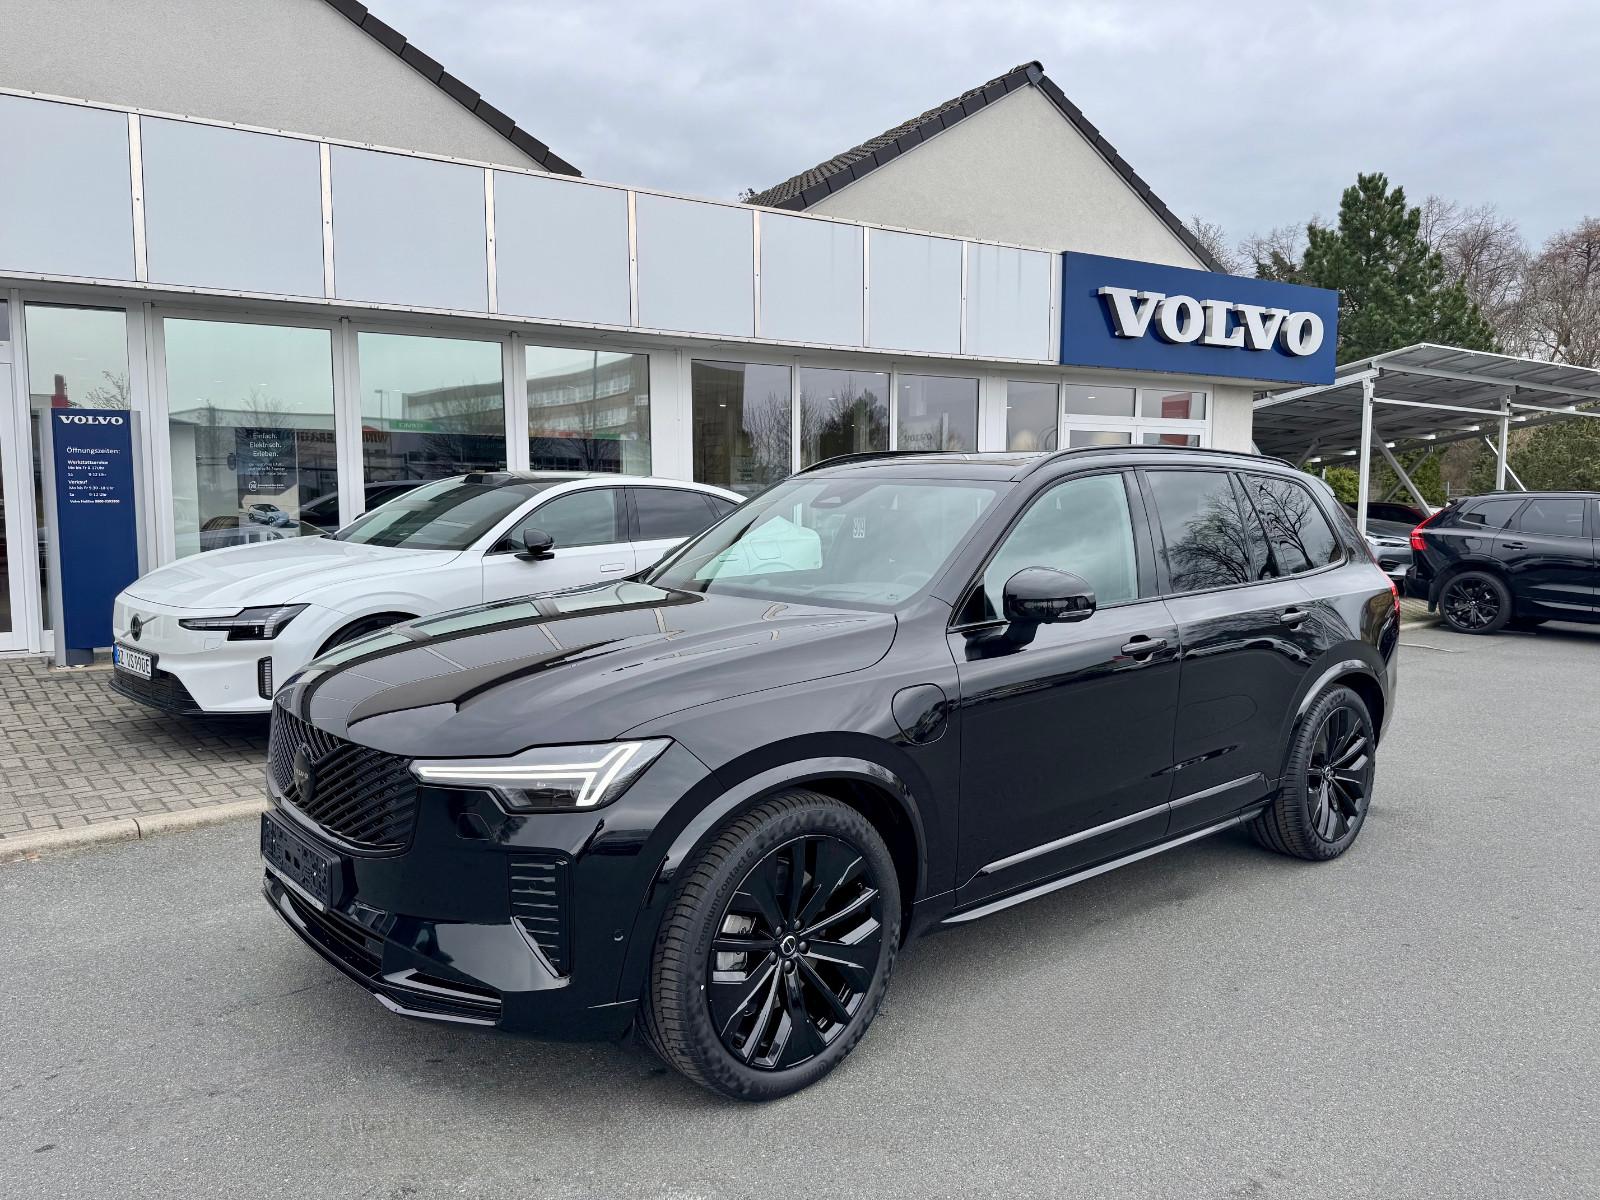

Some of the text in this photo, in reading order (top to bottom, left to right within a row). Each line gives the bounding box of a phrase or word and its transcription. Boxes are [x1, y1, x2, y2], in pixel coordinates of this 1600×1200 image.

[1098, 285, 1324, 356] VOLVO
[58, 415, 123, 425] VOLVO
[66, 446, 121, 455] Öffnungszeiten:
[695, 847, 754, 953] PremiumContact 6
